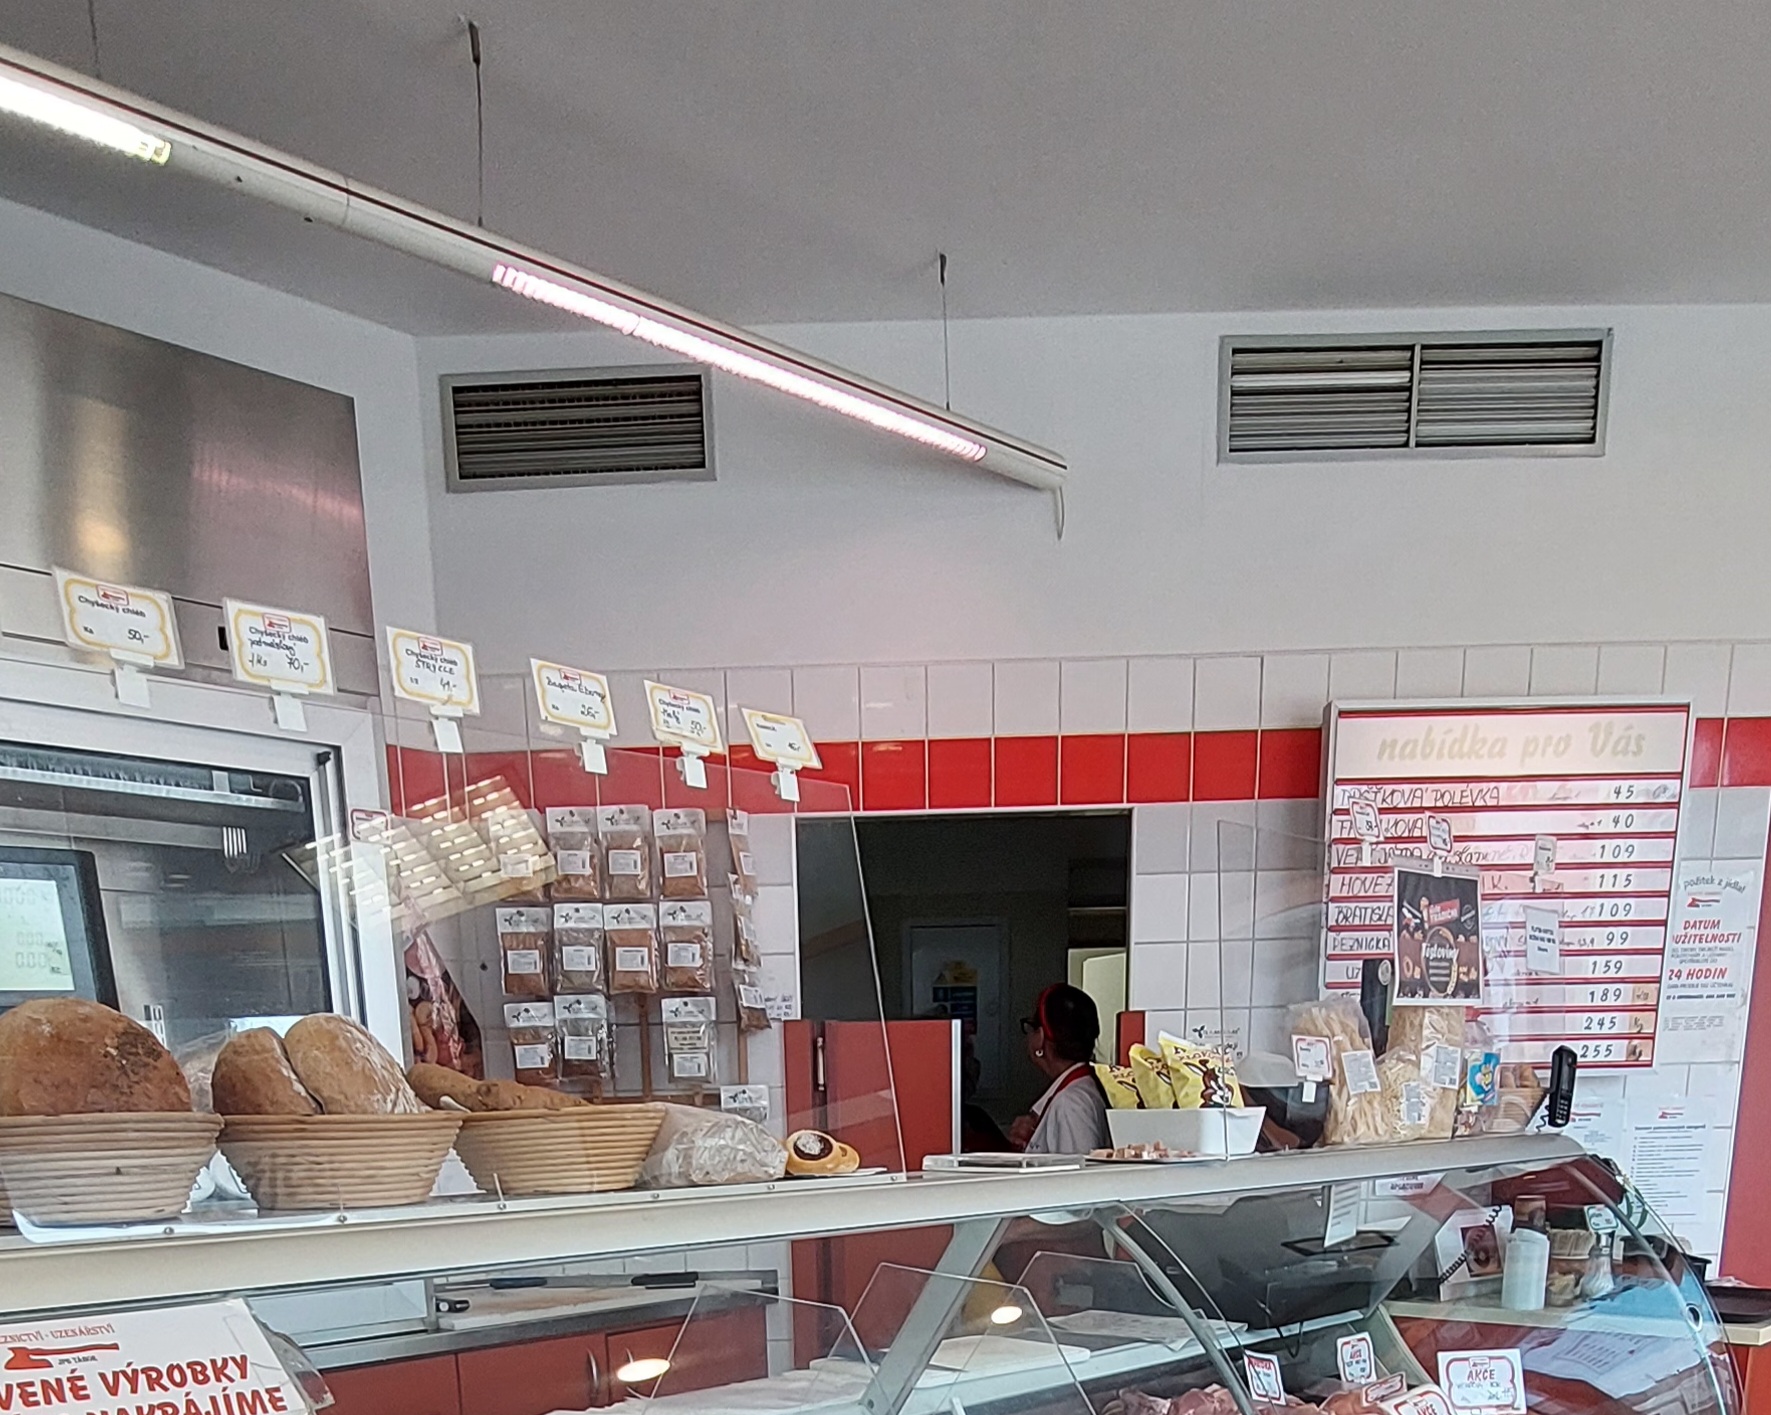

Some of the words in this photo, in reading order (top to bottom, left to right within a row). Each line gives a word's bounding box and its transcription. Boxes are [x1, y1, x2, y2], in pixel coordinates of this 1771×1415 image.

[127, 628, 150, 644] 50,-
[1377, 724, 1508, 761] nabídka
[1519, 732, 1573, 769] pro
[1587, 720, 1647, 758] Vás
[1430, 783, 1501, 809] POLÉVKA
[1612, 784, 1635, 800] 45
[1611, 813, 1635, 829] 40
[1599, 844, 1635, 859] 109
[1598, 873, 1633, 888] 115
[1684, 875, 1715, 891] požitek
[1335, 905, 1394, 925] BRATISLA
[1598, 902, 1632, 918] 109
[1683, 919, 1721, 931] DATUM
[1606, 931, 1629, 946] 99
[1672, 931, 1742, 945] UŽITELNOSTI
[1591, 960, 1623, 975] 159
[1668, 968, 1683, 981] 24
[1685, 966, 1728, 981] HODIN
[1588, 987, 1622, 1003] 189
[1583, 1016, 1617, 1031] 245
[1579, 1044, 1613, 1059] 255
[97, 1352, 250, 1396] VÝROBKY
[1466, 1368, 1496, 1381] AKCE
